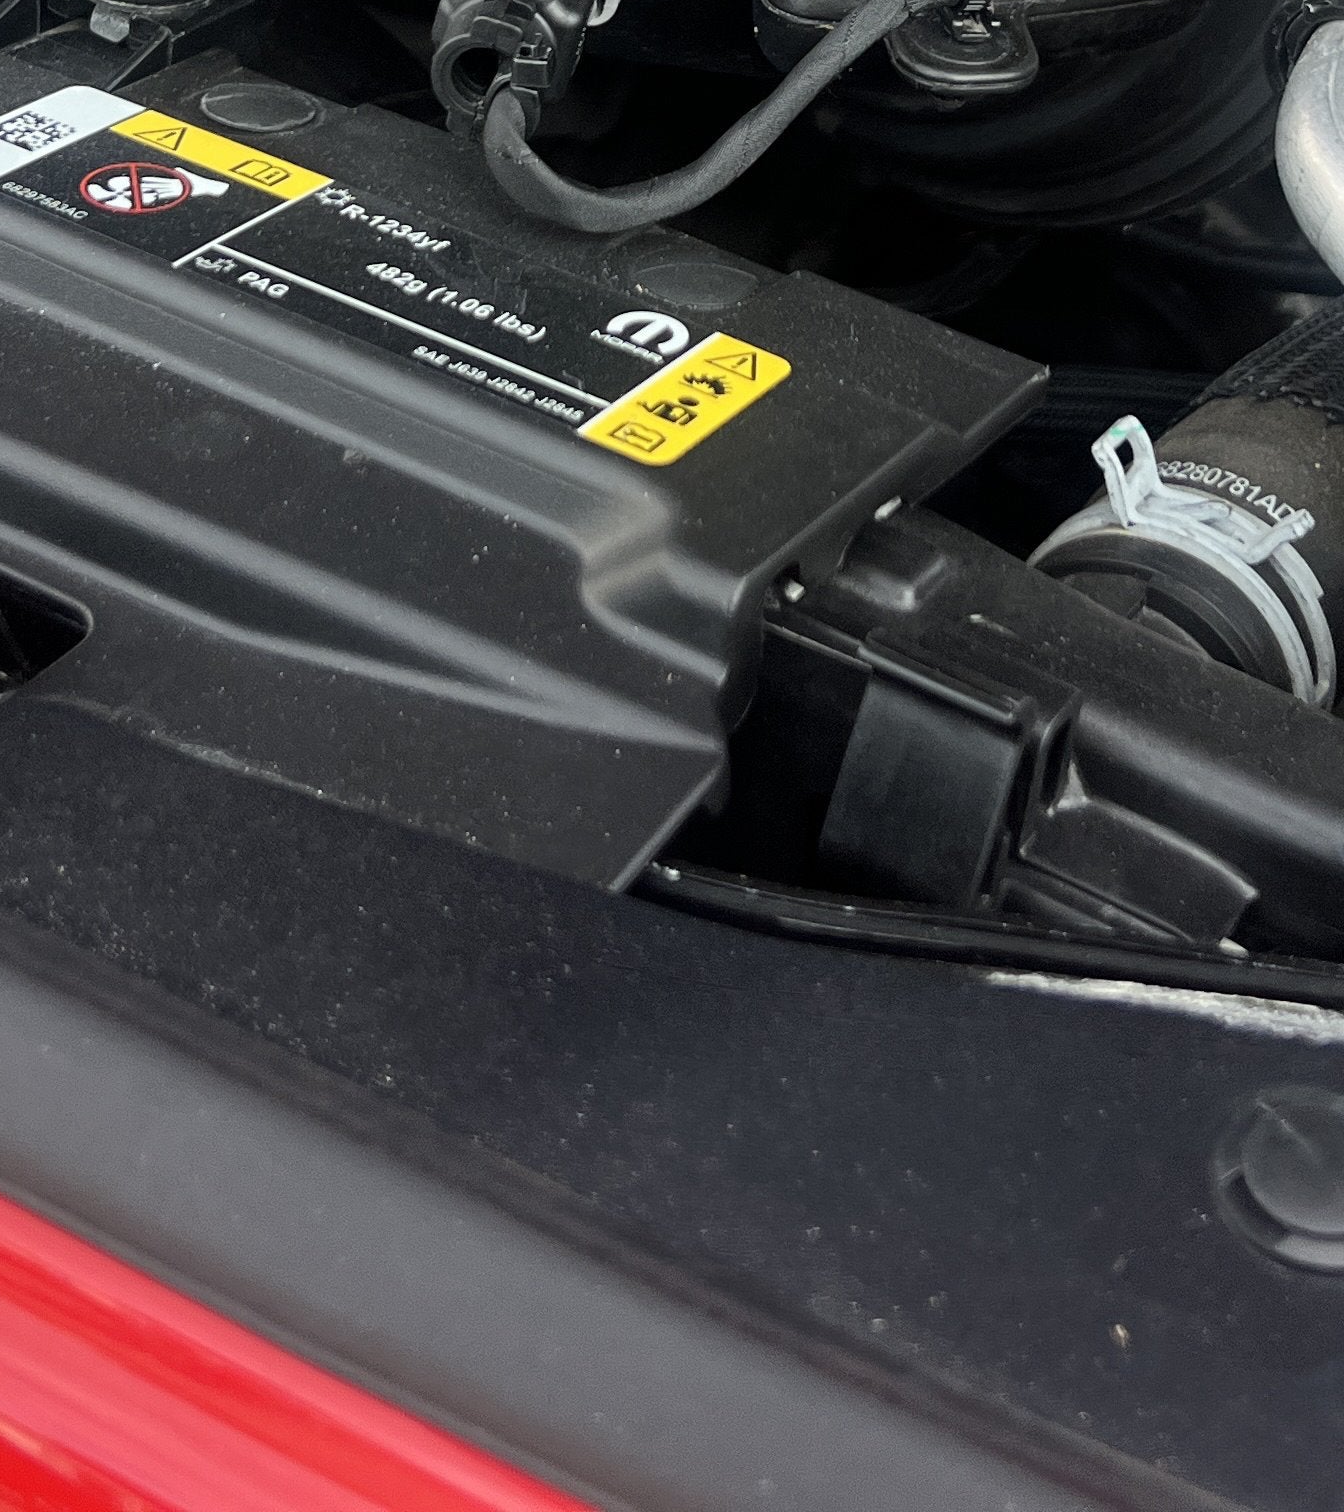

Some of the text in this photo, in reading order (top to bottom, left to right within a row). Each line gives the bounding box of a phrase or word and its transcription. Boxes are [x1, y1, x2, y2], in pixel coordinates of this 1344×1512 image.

[339, 204, 451, 252] R-1234yf
[237, 271, 290, 298] PAG
[365, 262, 546, 343] 482g (1.06 lbs)
[412, 346, 450, 367] SAE
